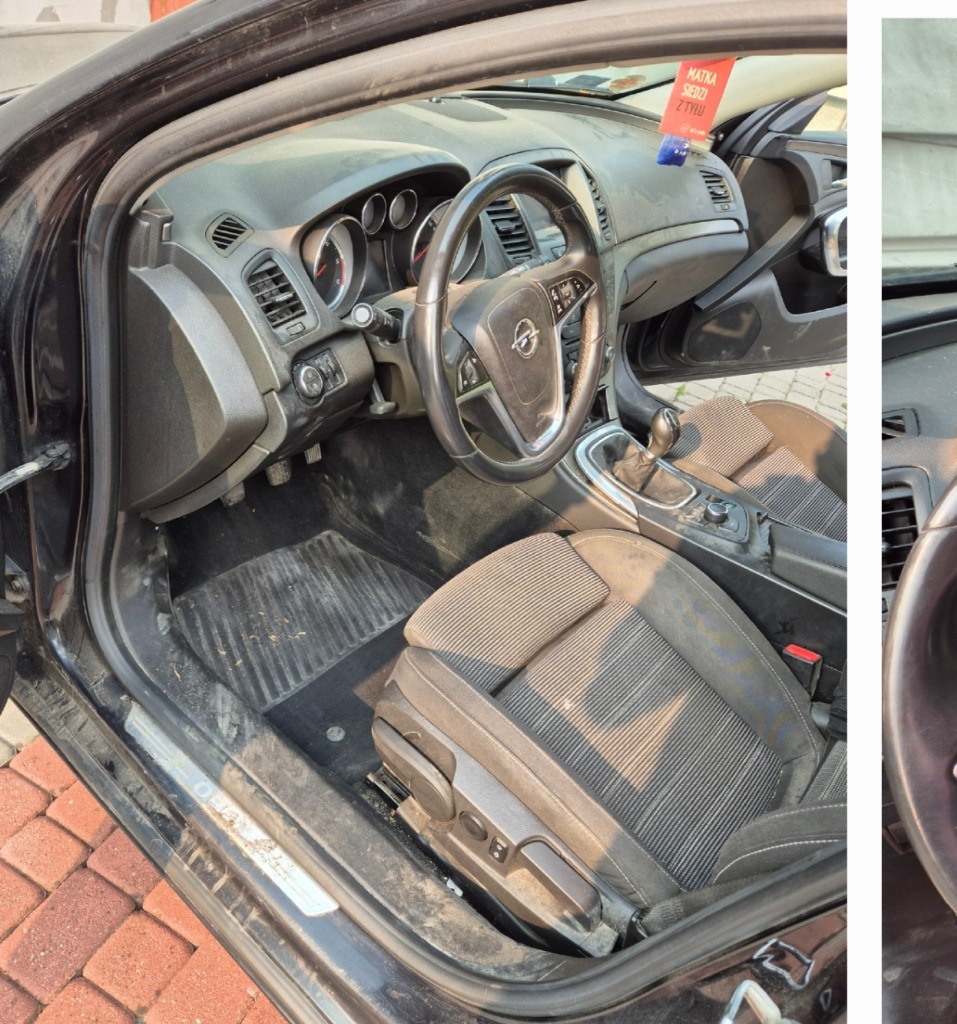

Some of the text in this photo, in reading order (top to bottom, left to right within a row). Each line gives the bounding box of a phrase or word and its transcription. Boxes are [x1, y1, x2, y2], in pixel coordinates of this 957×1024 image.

[687, 67, 717, 85] MATKA
[681, 83, 708, 101] SIEDZI
[676, 100, 706, 117] Z TYŁU
